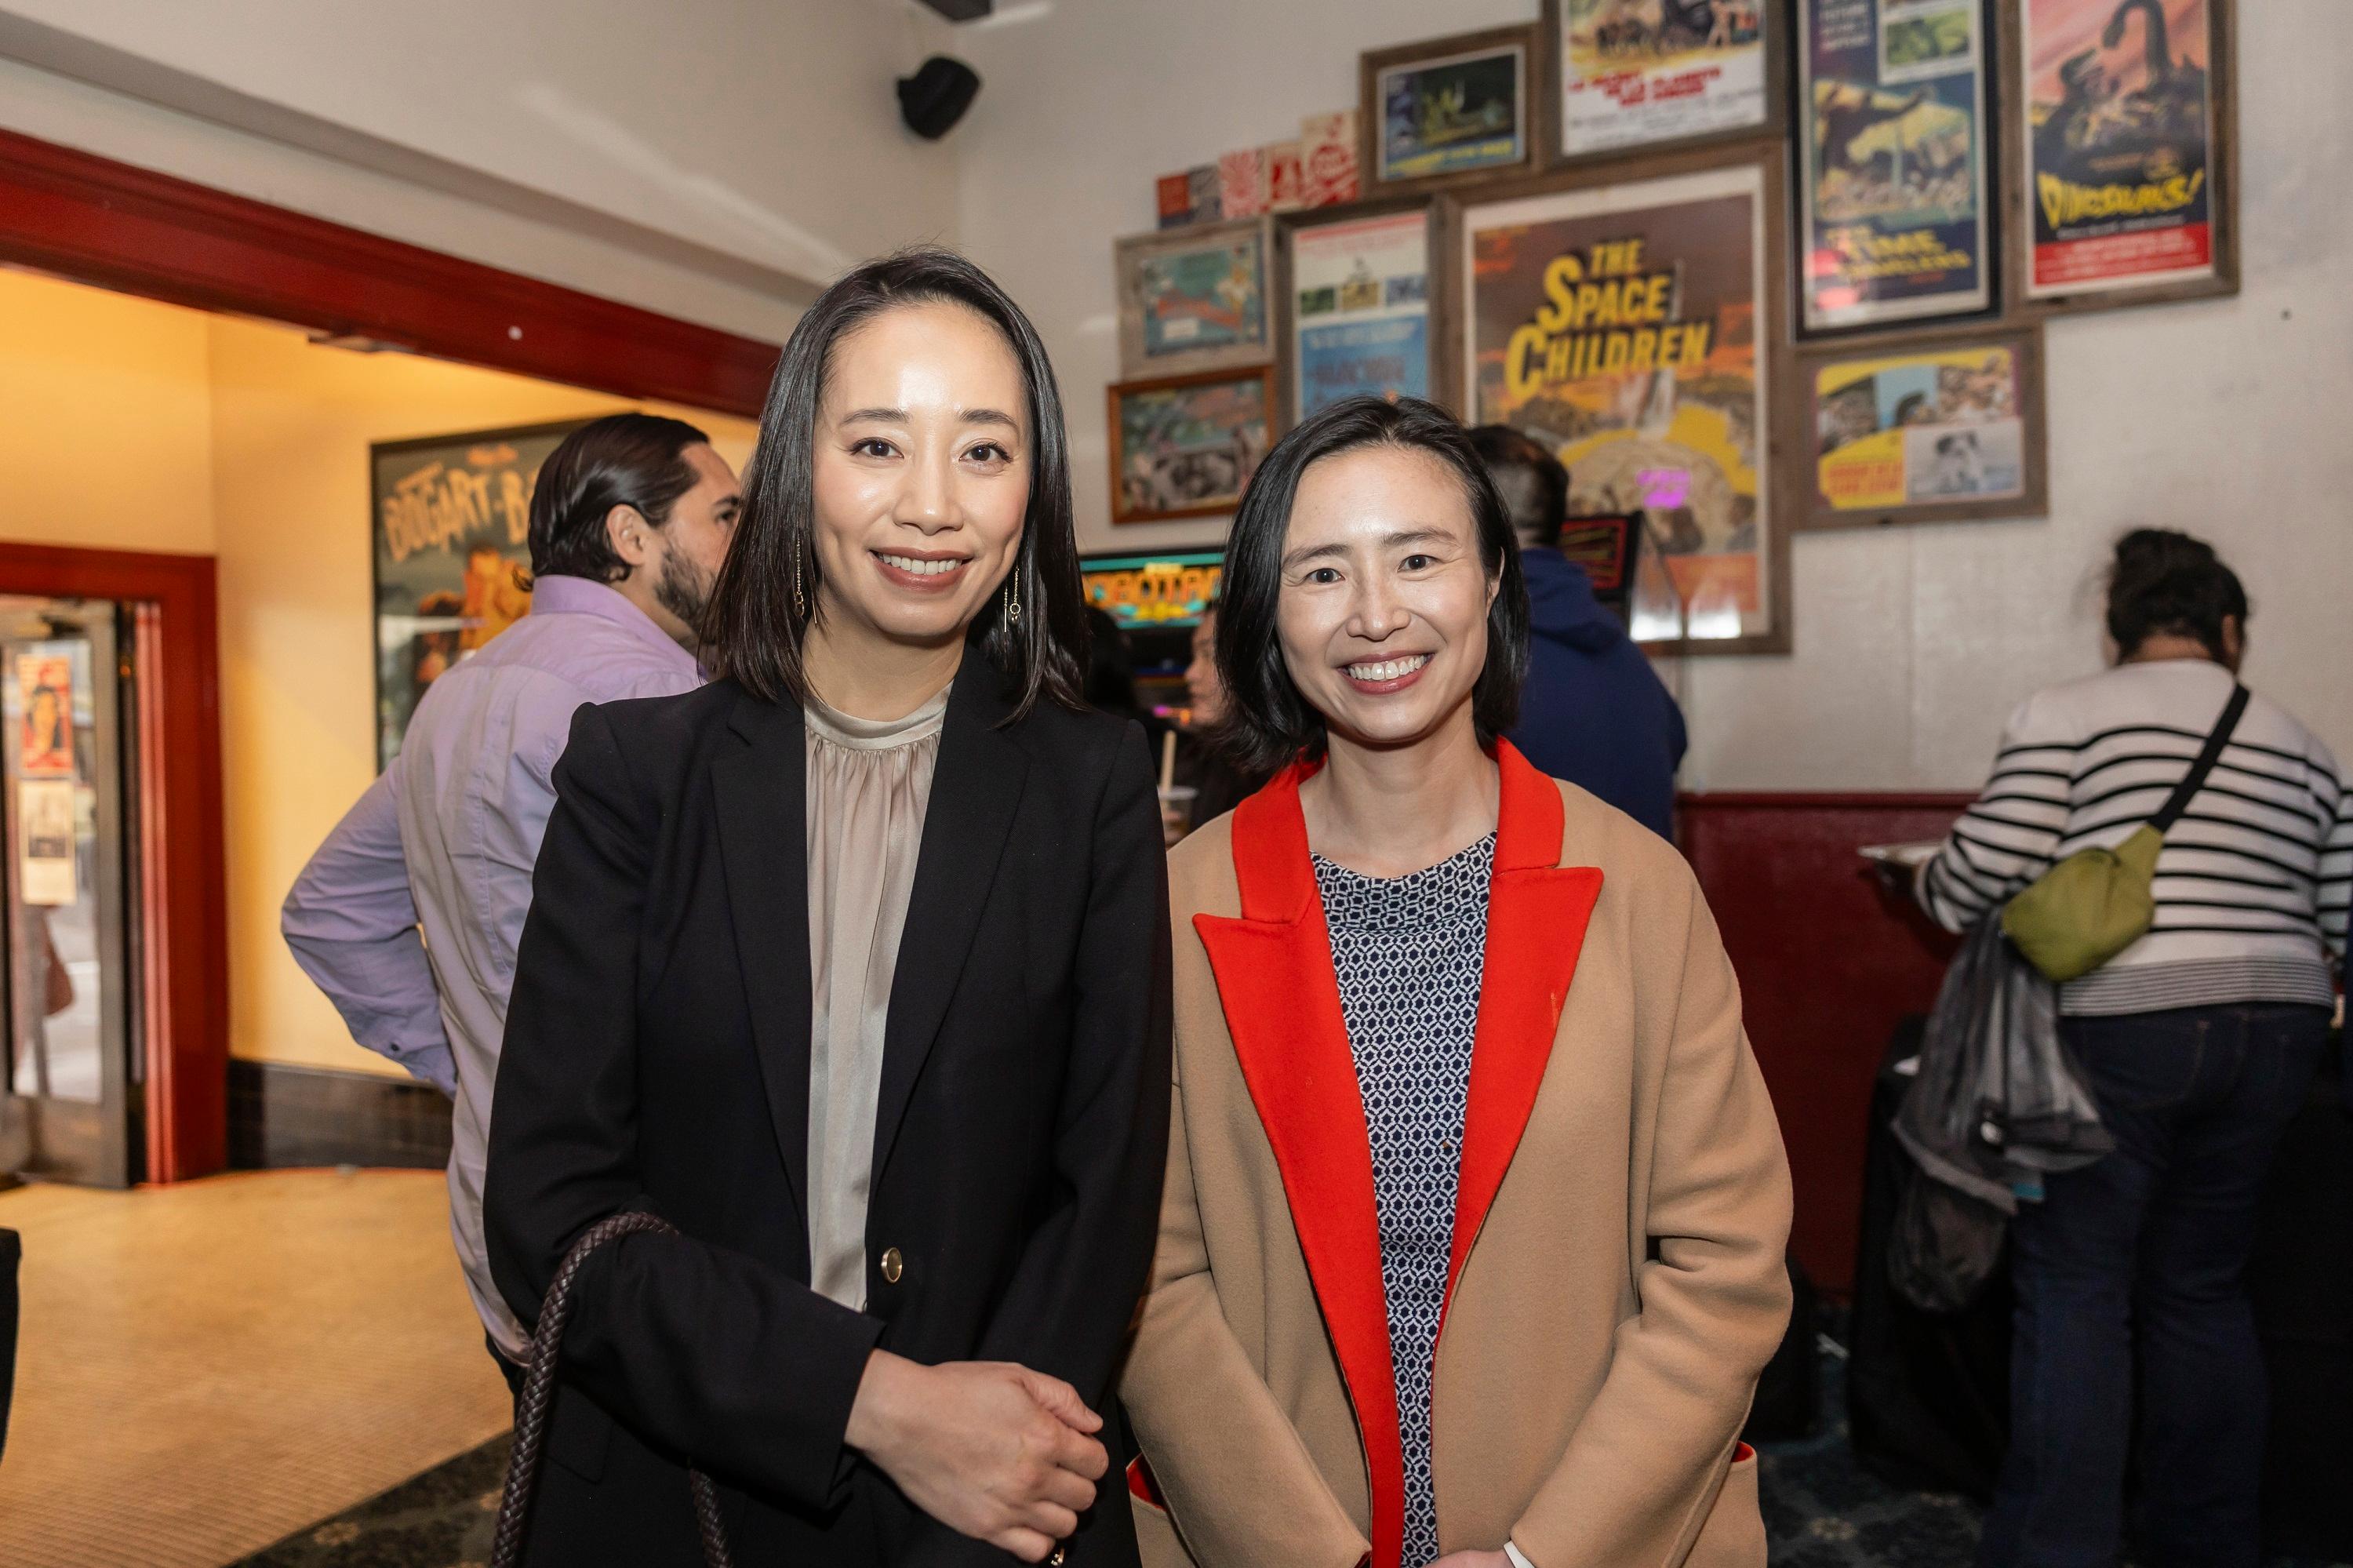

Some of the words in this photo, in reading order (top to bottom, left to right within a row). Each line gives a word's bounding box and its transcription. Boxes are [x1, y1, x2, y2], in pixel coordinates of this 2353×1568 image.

[2037, 169, 2204, 227] DINOSAURS!
[1590, 238, 1642, 274] THE
[1537, 255, 1670, 333] SPACE
[1504, 322, 1710, 398] CHILDREN
